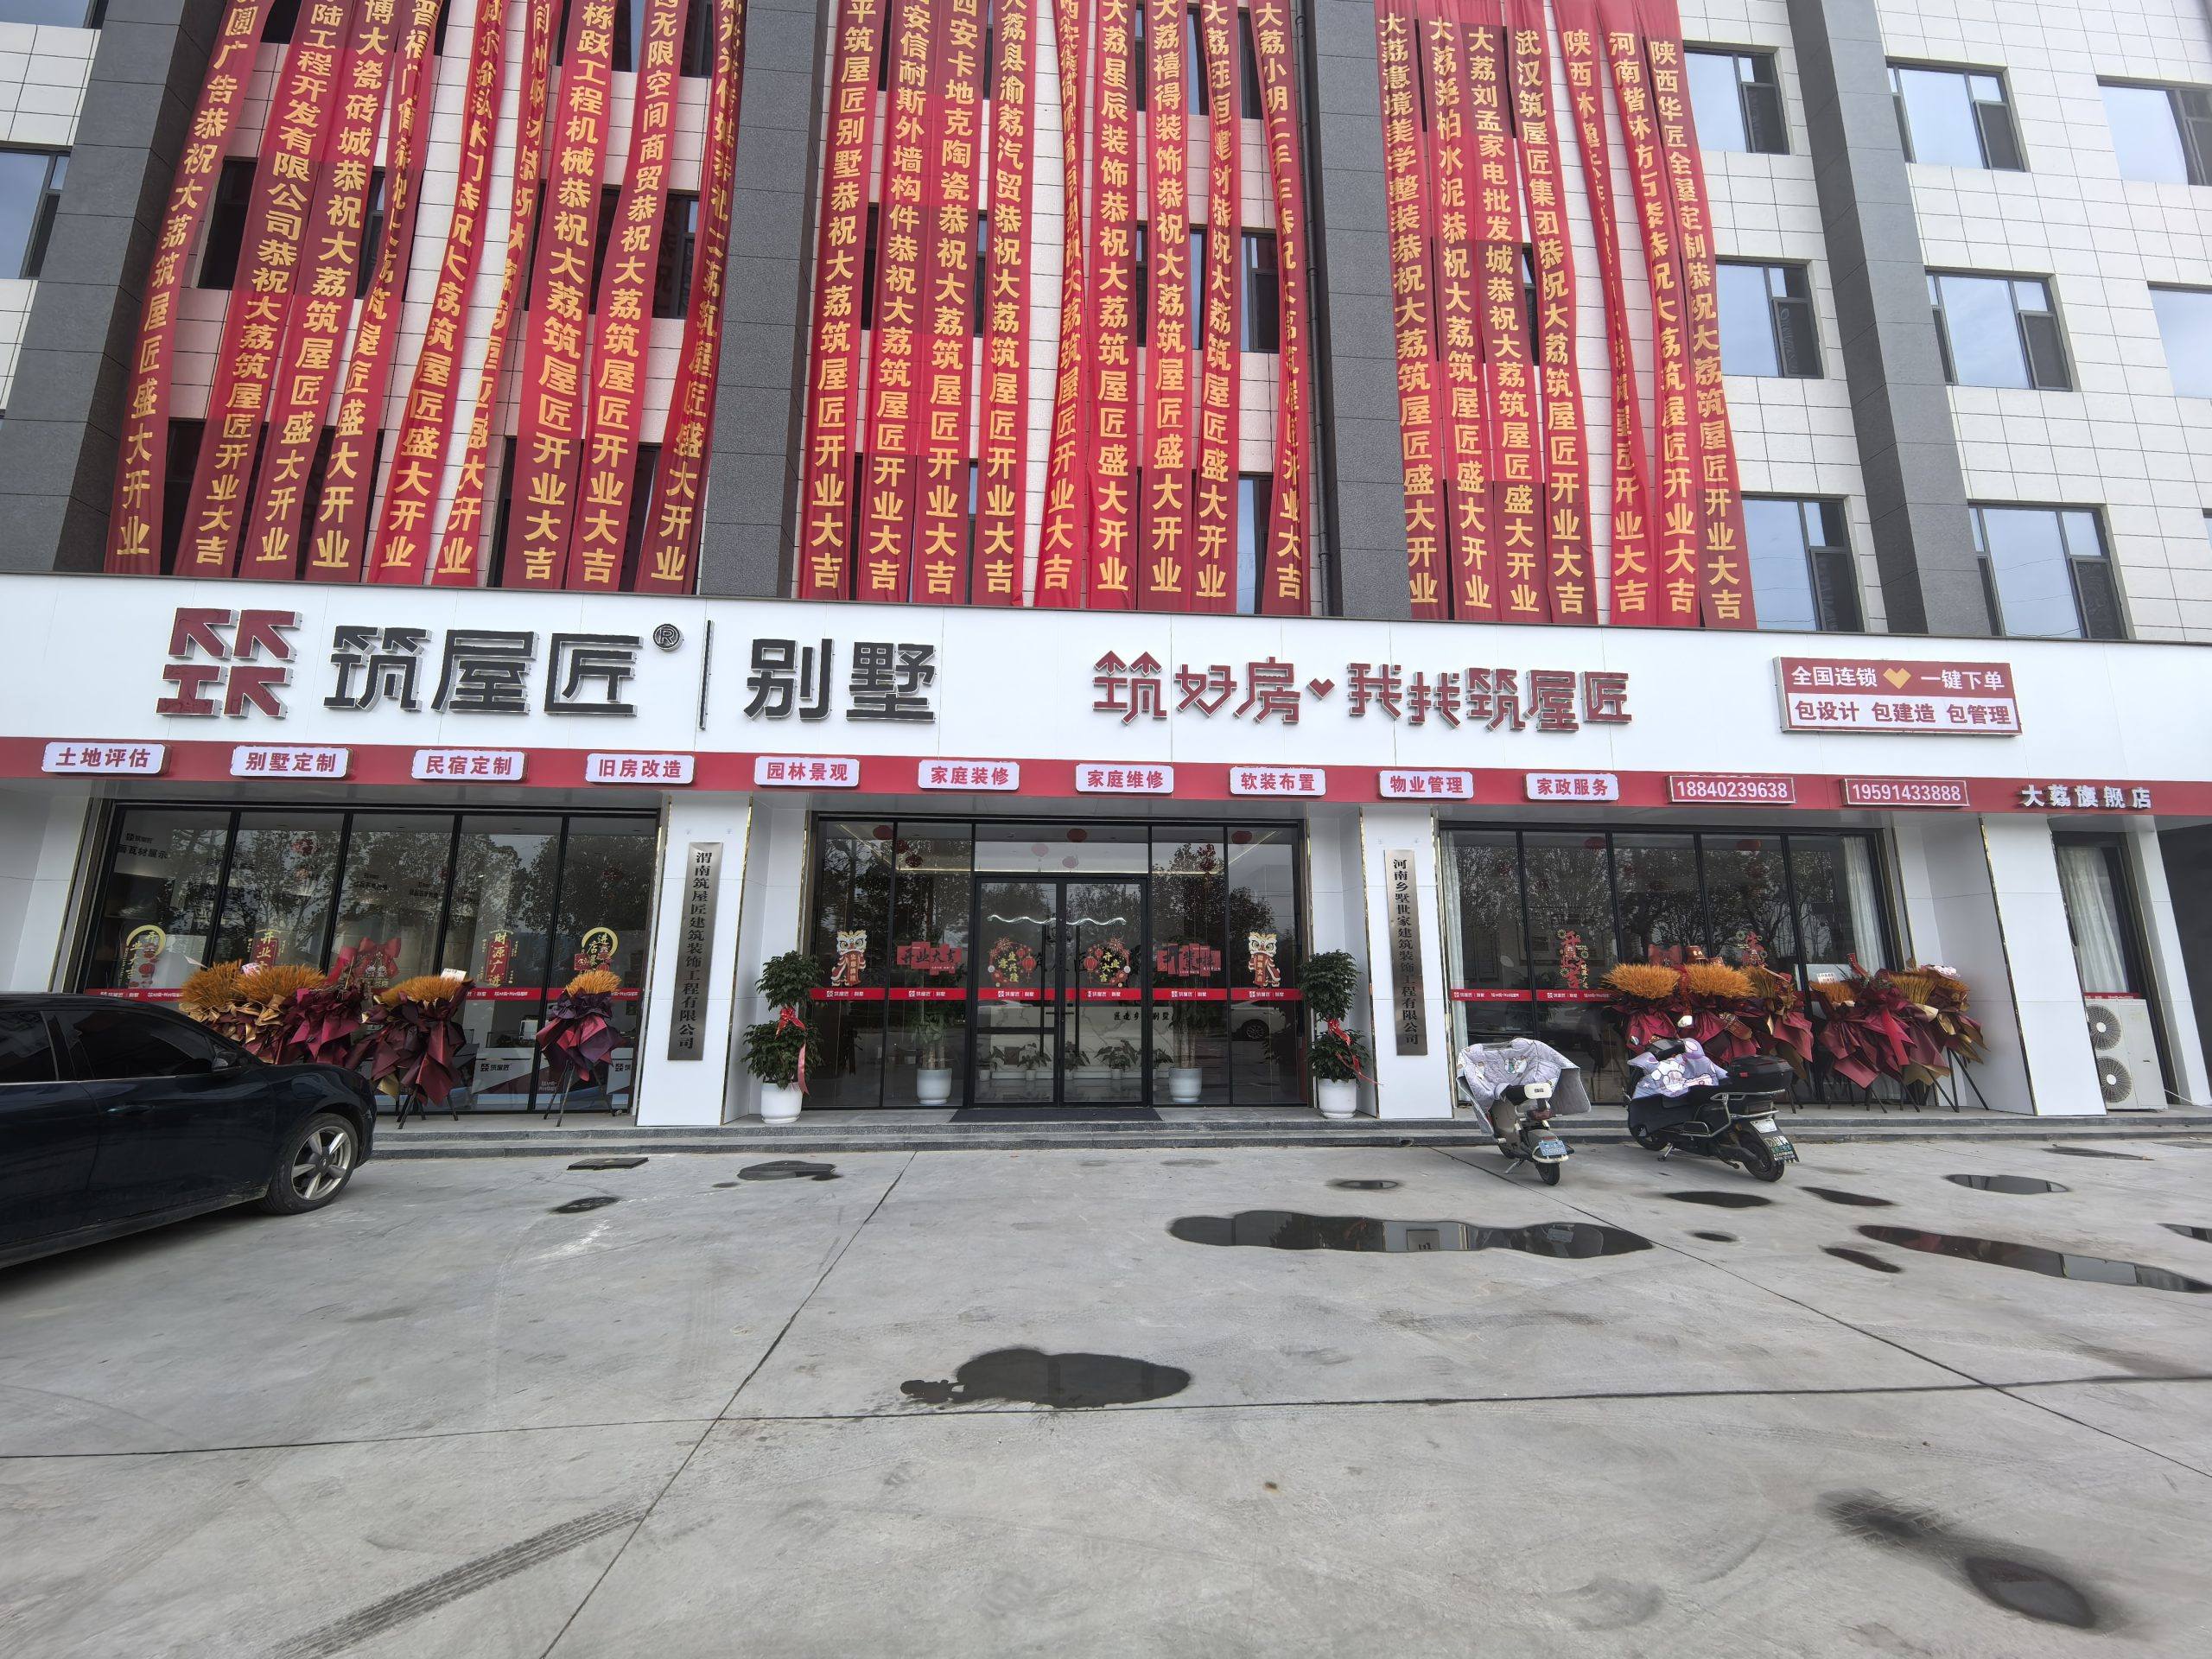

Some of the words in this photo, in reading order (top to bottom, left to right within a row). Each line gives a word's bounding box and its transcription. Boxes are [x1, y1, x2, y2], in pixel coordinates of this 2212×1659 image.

[117, 0, 258, 555] 圆广告恭祝大荔筑屋匠盛大开业
[195, 0, 343, 566] 陆工程开发有限公司恭祝大荔筑屋匠开业大吉
[524, 0, 614, 580] 栋跃工程机械恭祝大荔筑屋匠开业大吉
[868, 0, 931, 591] 安信耐斯外墙构件恭祝大荔筑屋匠开业大吉
[323, 626, 645, 717] 筑屋匠
[743, 638, 938, 724] 别墅
[1791, 665, 1878, 688] 全国连锁
[1920, 668, 2005, 691] 一键下单
[1093, 650, 1300, 725] 筑好房
[1347, 662, 1634, 734] 我找筑屋匠
[1795, 700, 1860, 722] 包设计
[1871, 702, 1936, 724] 包建造
[1947, 703, 2011, 726] 包管理
[55, 747, 150, 767] 土地评估
[245, 752, 336, 772] 别墅定制
[426, 754, 512, 776] 民宿定制
[598, 759, 683, 779] 旧房改造
[766, 761, 849, 782] 园林景观
[931, 765, 1010, 785] 家庭装修
[1086, 768, 1164, 789] 家庭维修
[1240, 772, 1316, 792] 软装布置
[1389, 774, 1464, 795] 物业管理
[1536, 777, 1609, 797] 家政服务
[1677, 781, 1788, 798] 18840239638
[1853, 784, 1961, 801] 19591433888
[2020, 784, 2152, 809] 大荔旗舰店
[678, 852, 713, 1049] 渭南筑屋匠建筑装饰工程有限公司
